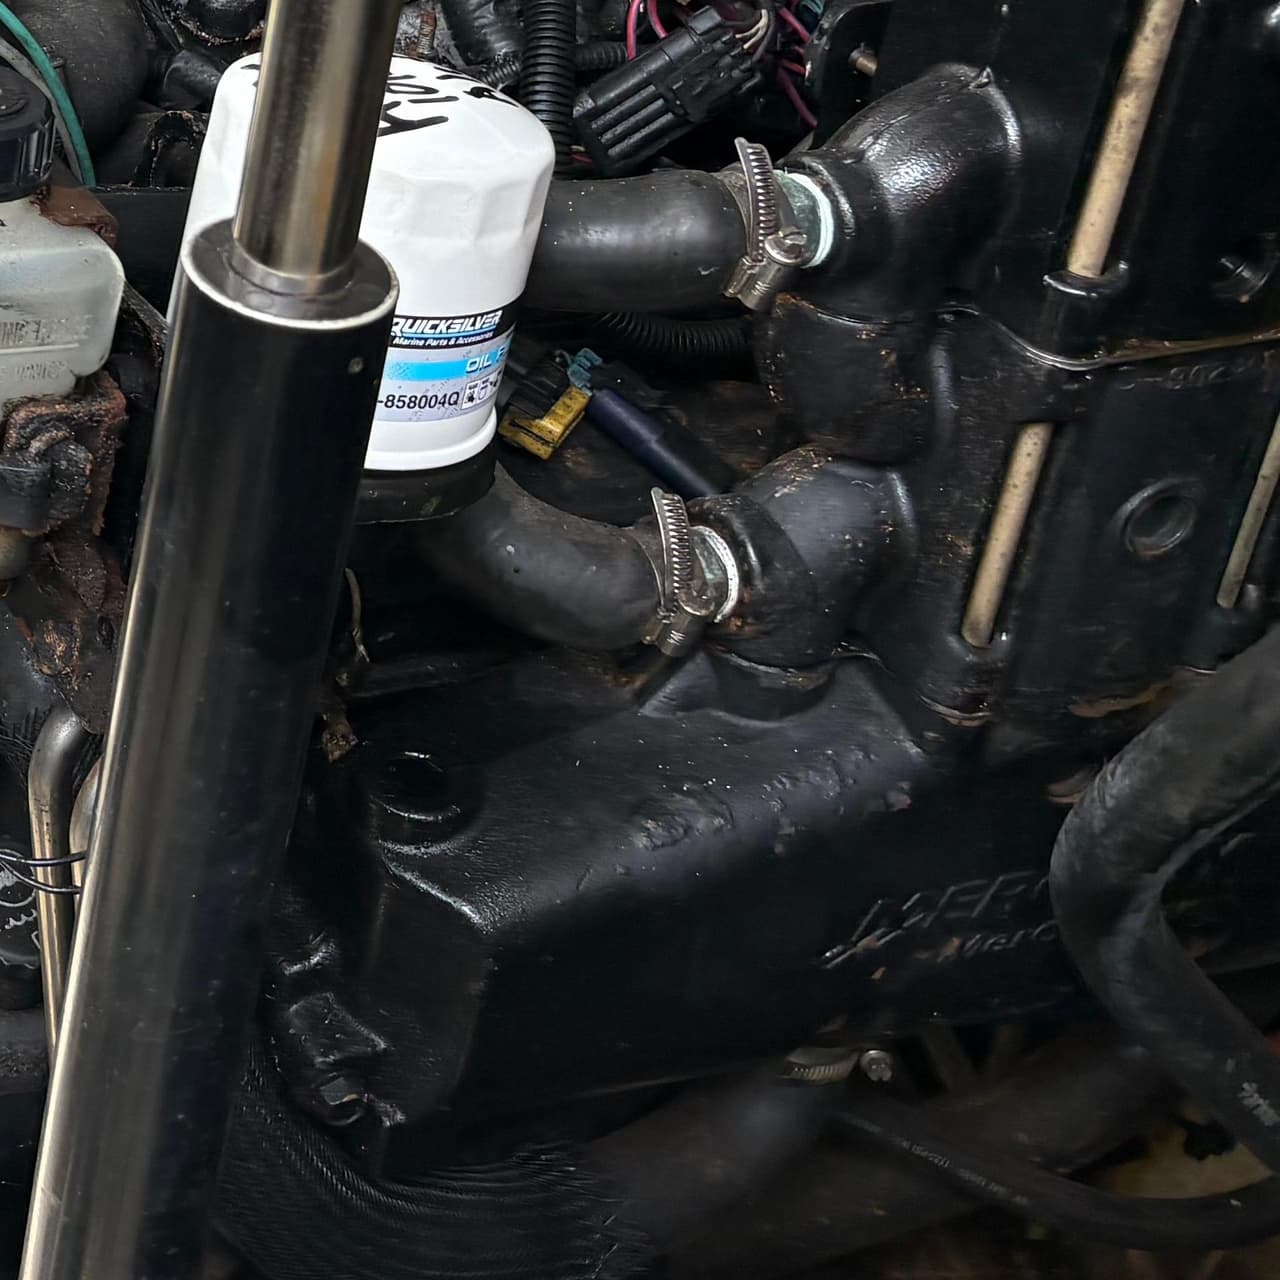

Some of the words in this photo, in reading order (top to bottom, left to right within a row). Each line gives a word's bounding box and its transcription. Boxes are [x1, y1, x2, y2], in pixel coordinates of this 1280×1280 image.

[391, 310, 503, 337] QUICKSILVER
[393, 336, 424, 347] Marine
[426, 337, 446, 347] Parts
[449, 336, 455, 345] &
[456, 331, 494, 345] Accessories
[466, 356, 492, 374] OIL
